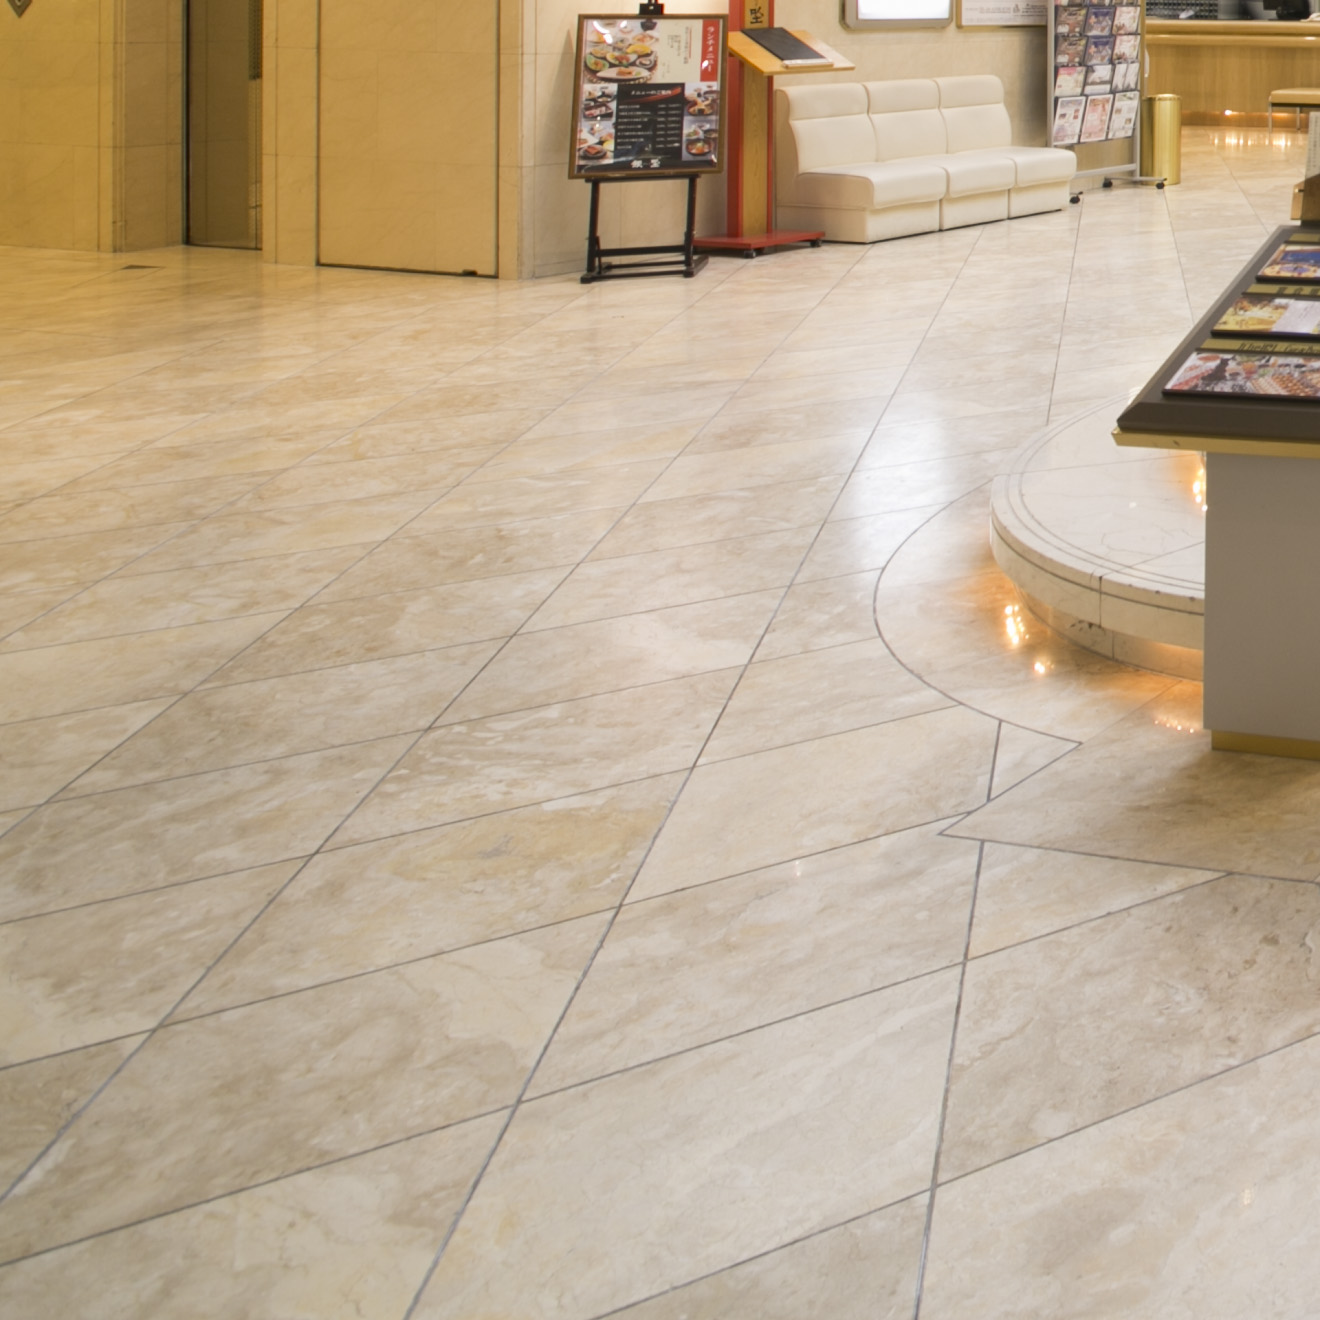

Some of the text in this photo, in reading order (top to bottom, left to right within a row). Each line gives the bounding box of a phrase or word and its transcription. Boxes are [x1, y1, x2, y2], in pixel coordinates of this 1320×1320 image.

[705, 26, 715, 72] ランチメニュー
